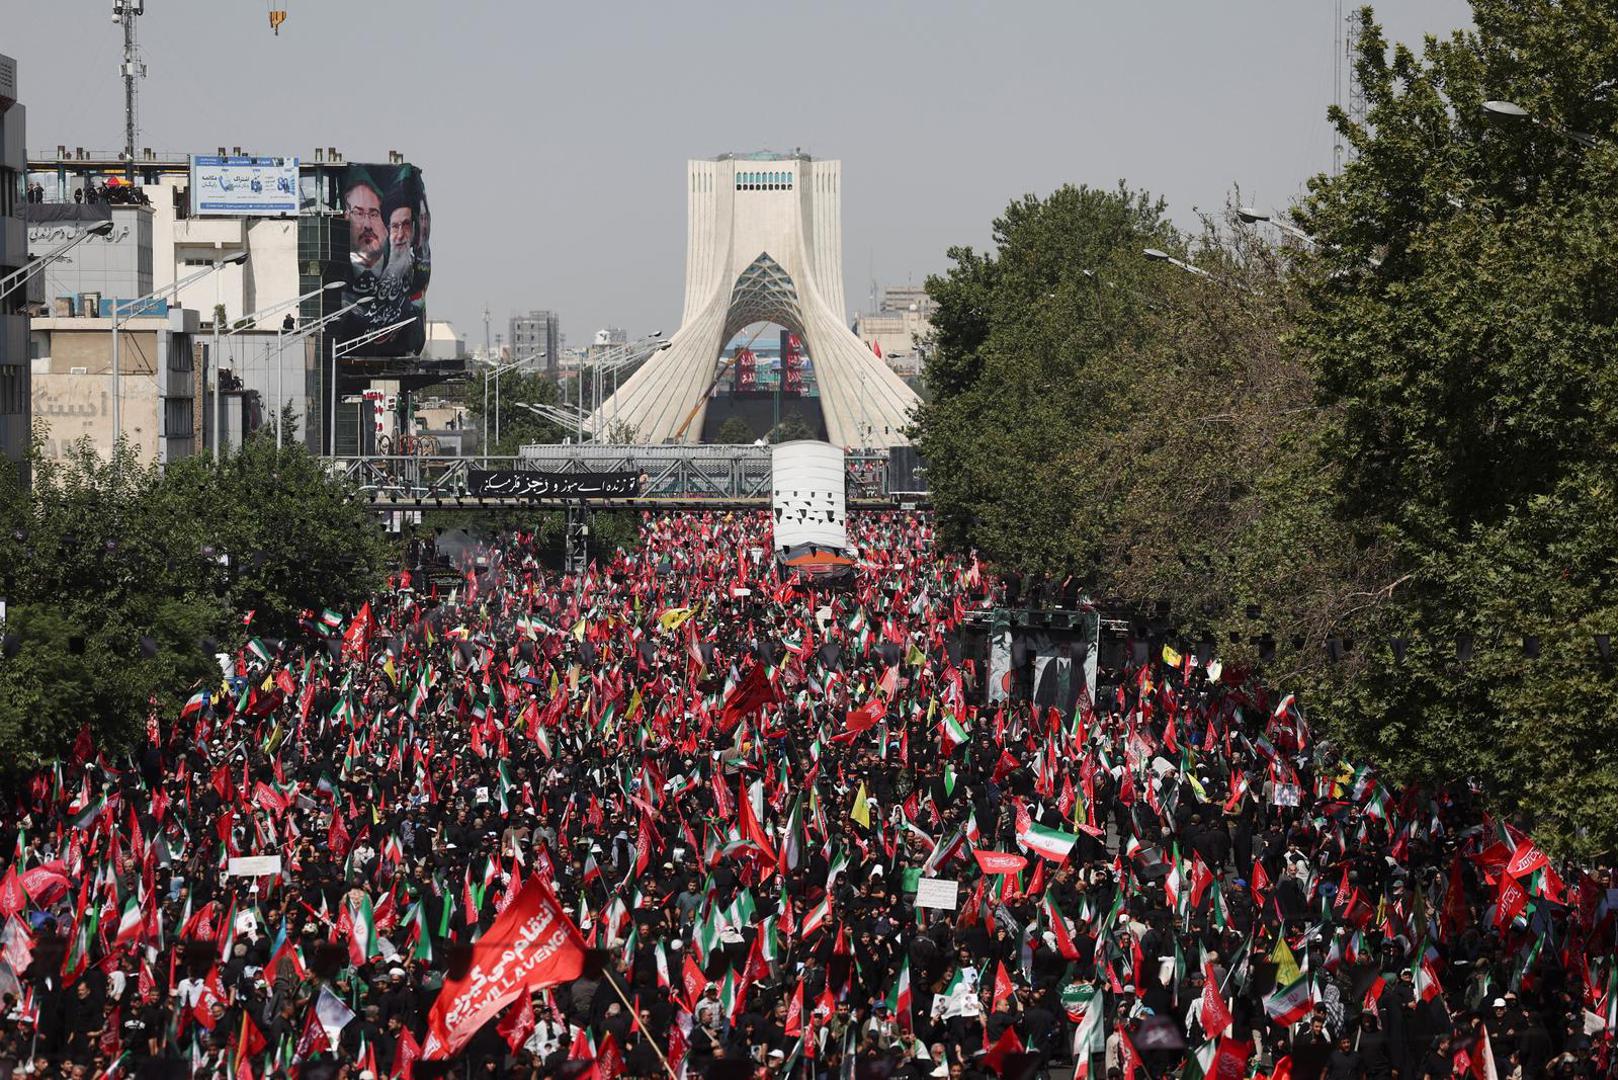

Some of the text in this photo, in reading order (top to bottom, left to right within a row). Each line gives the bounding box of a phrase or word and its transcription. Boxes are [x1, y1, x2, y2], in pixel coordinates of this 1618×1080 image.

[552, 483, 559, 492] و
[628, 477, 636, 490] تو
[514, 897, 558, 961] انتقام
[515, 921, 571, 982] AVENGE
